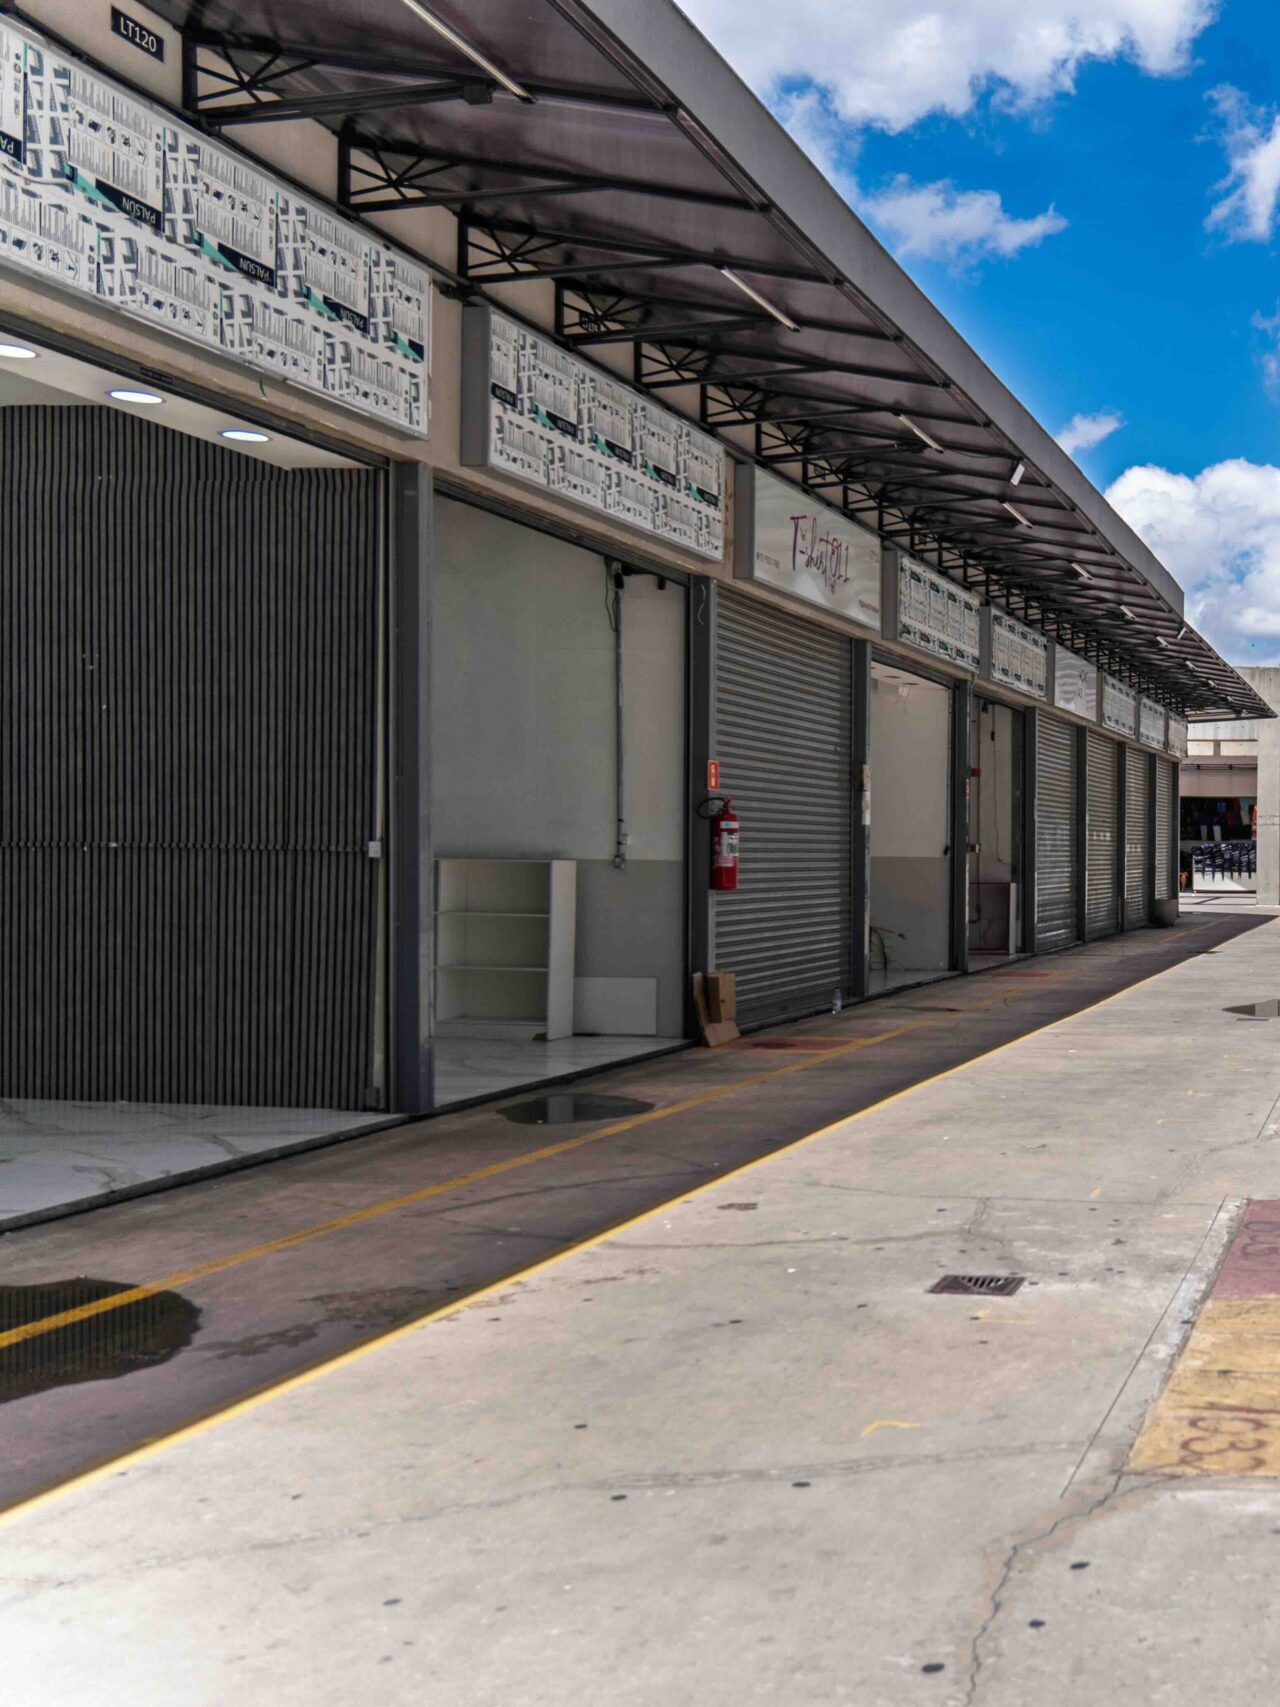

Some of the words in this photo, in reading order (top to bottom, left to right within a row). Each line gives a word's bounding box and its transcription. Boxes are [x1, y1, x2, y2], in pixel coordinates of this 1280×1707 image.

[120, 16, 157, 53] LT120
[122, 197, 157, 224] PALSUN
[239, 257, 271, 282] PALSUN
